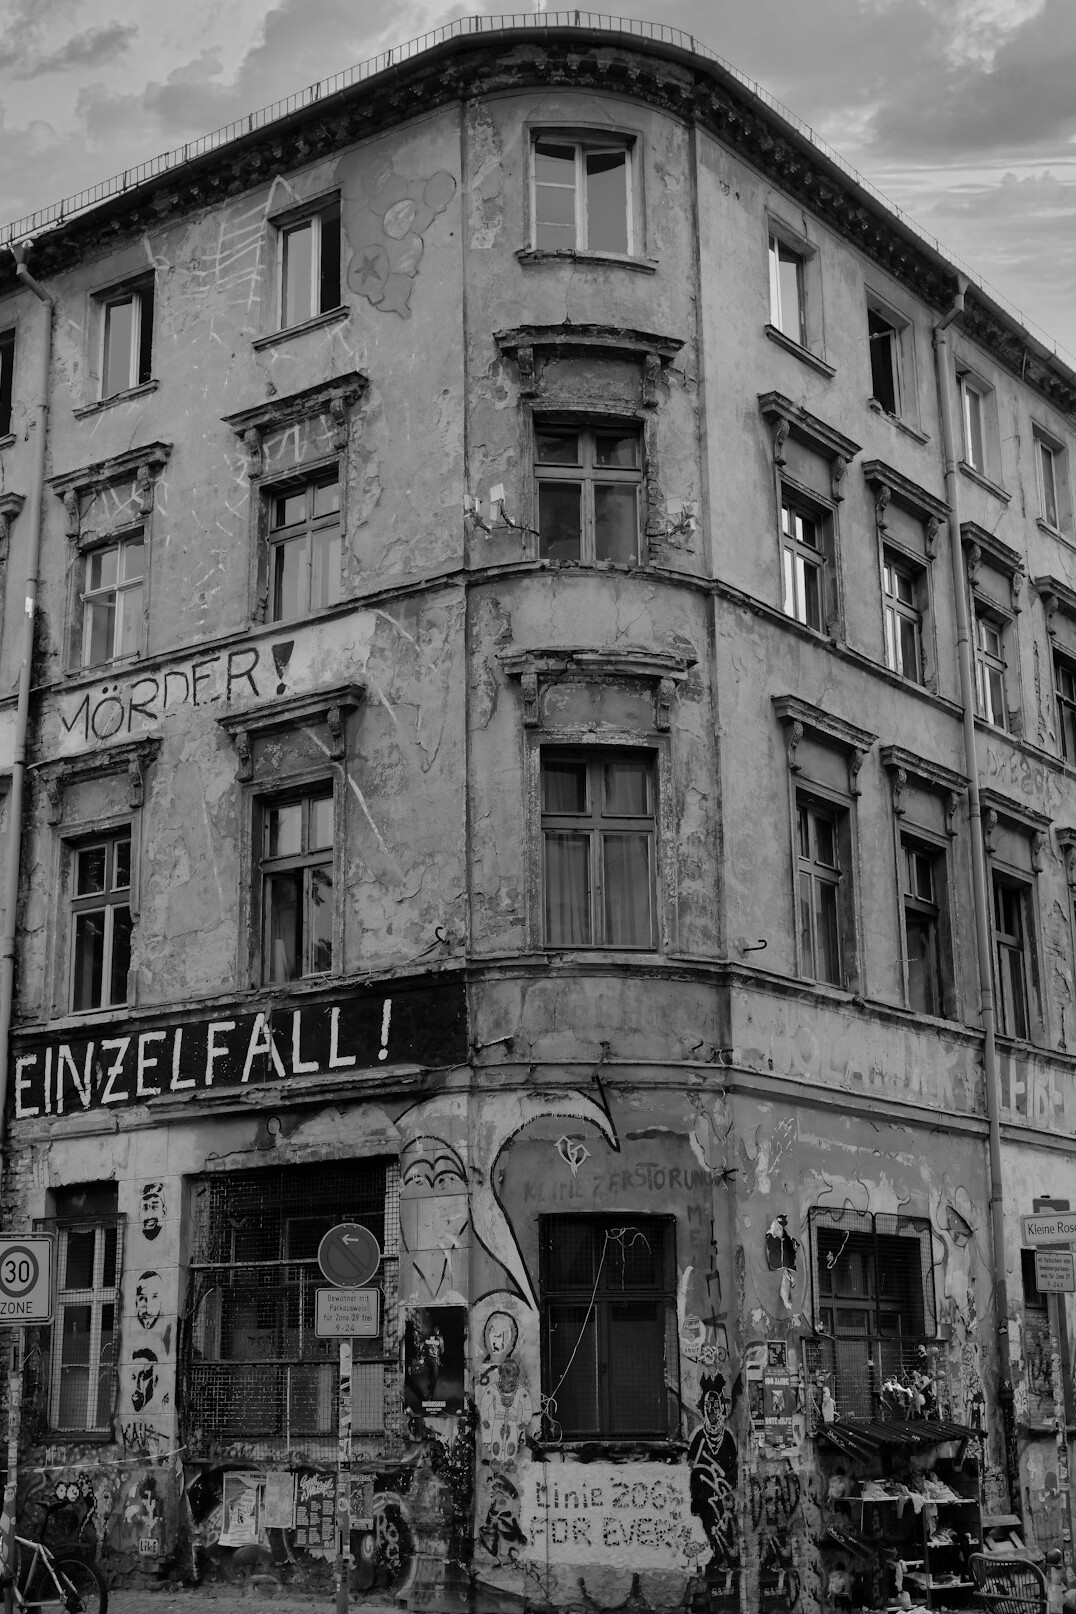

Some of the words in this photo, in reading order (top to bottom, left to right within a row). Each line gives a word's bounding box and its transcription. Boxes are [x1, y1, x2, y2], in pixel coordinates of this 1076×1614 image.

[61, 640, 295, 742] MÖRDER!
[14, 999, 393, 1118] EINZELFALL!
[1027, 1222, 1055, 1235] Kleine
[5, 1260, 30, 1284] 30
[0, 1301, 33, 1314] ZONE
[611, 1480, 667, 1509] 206
